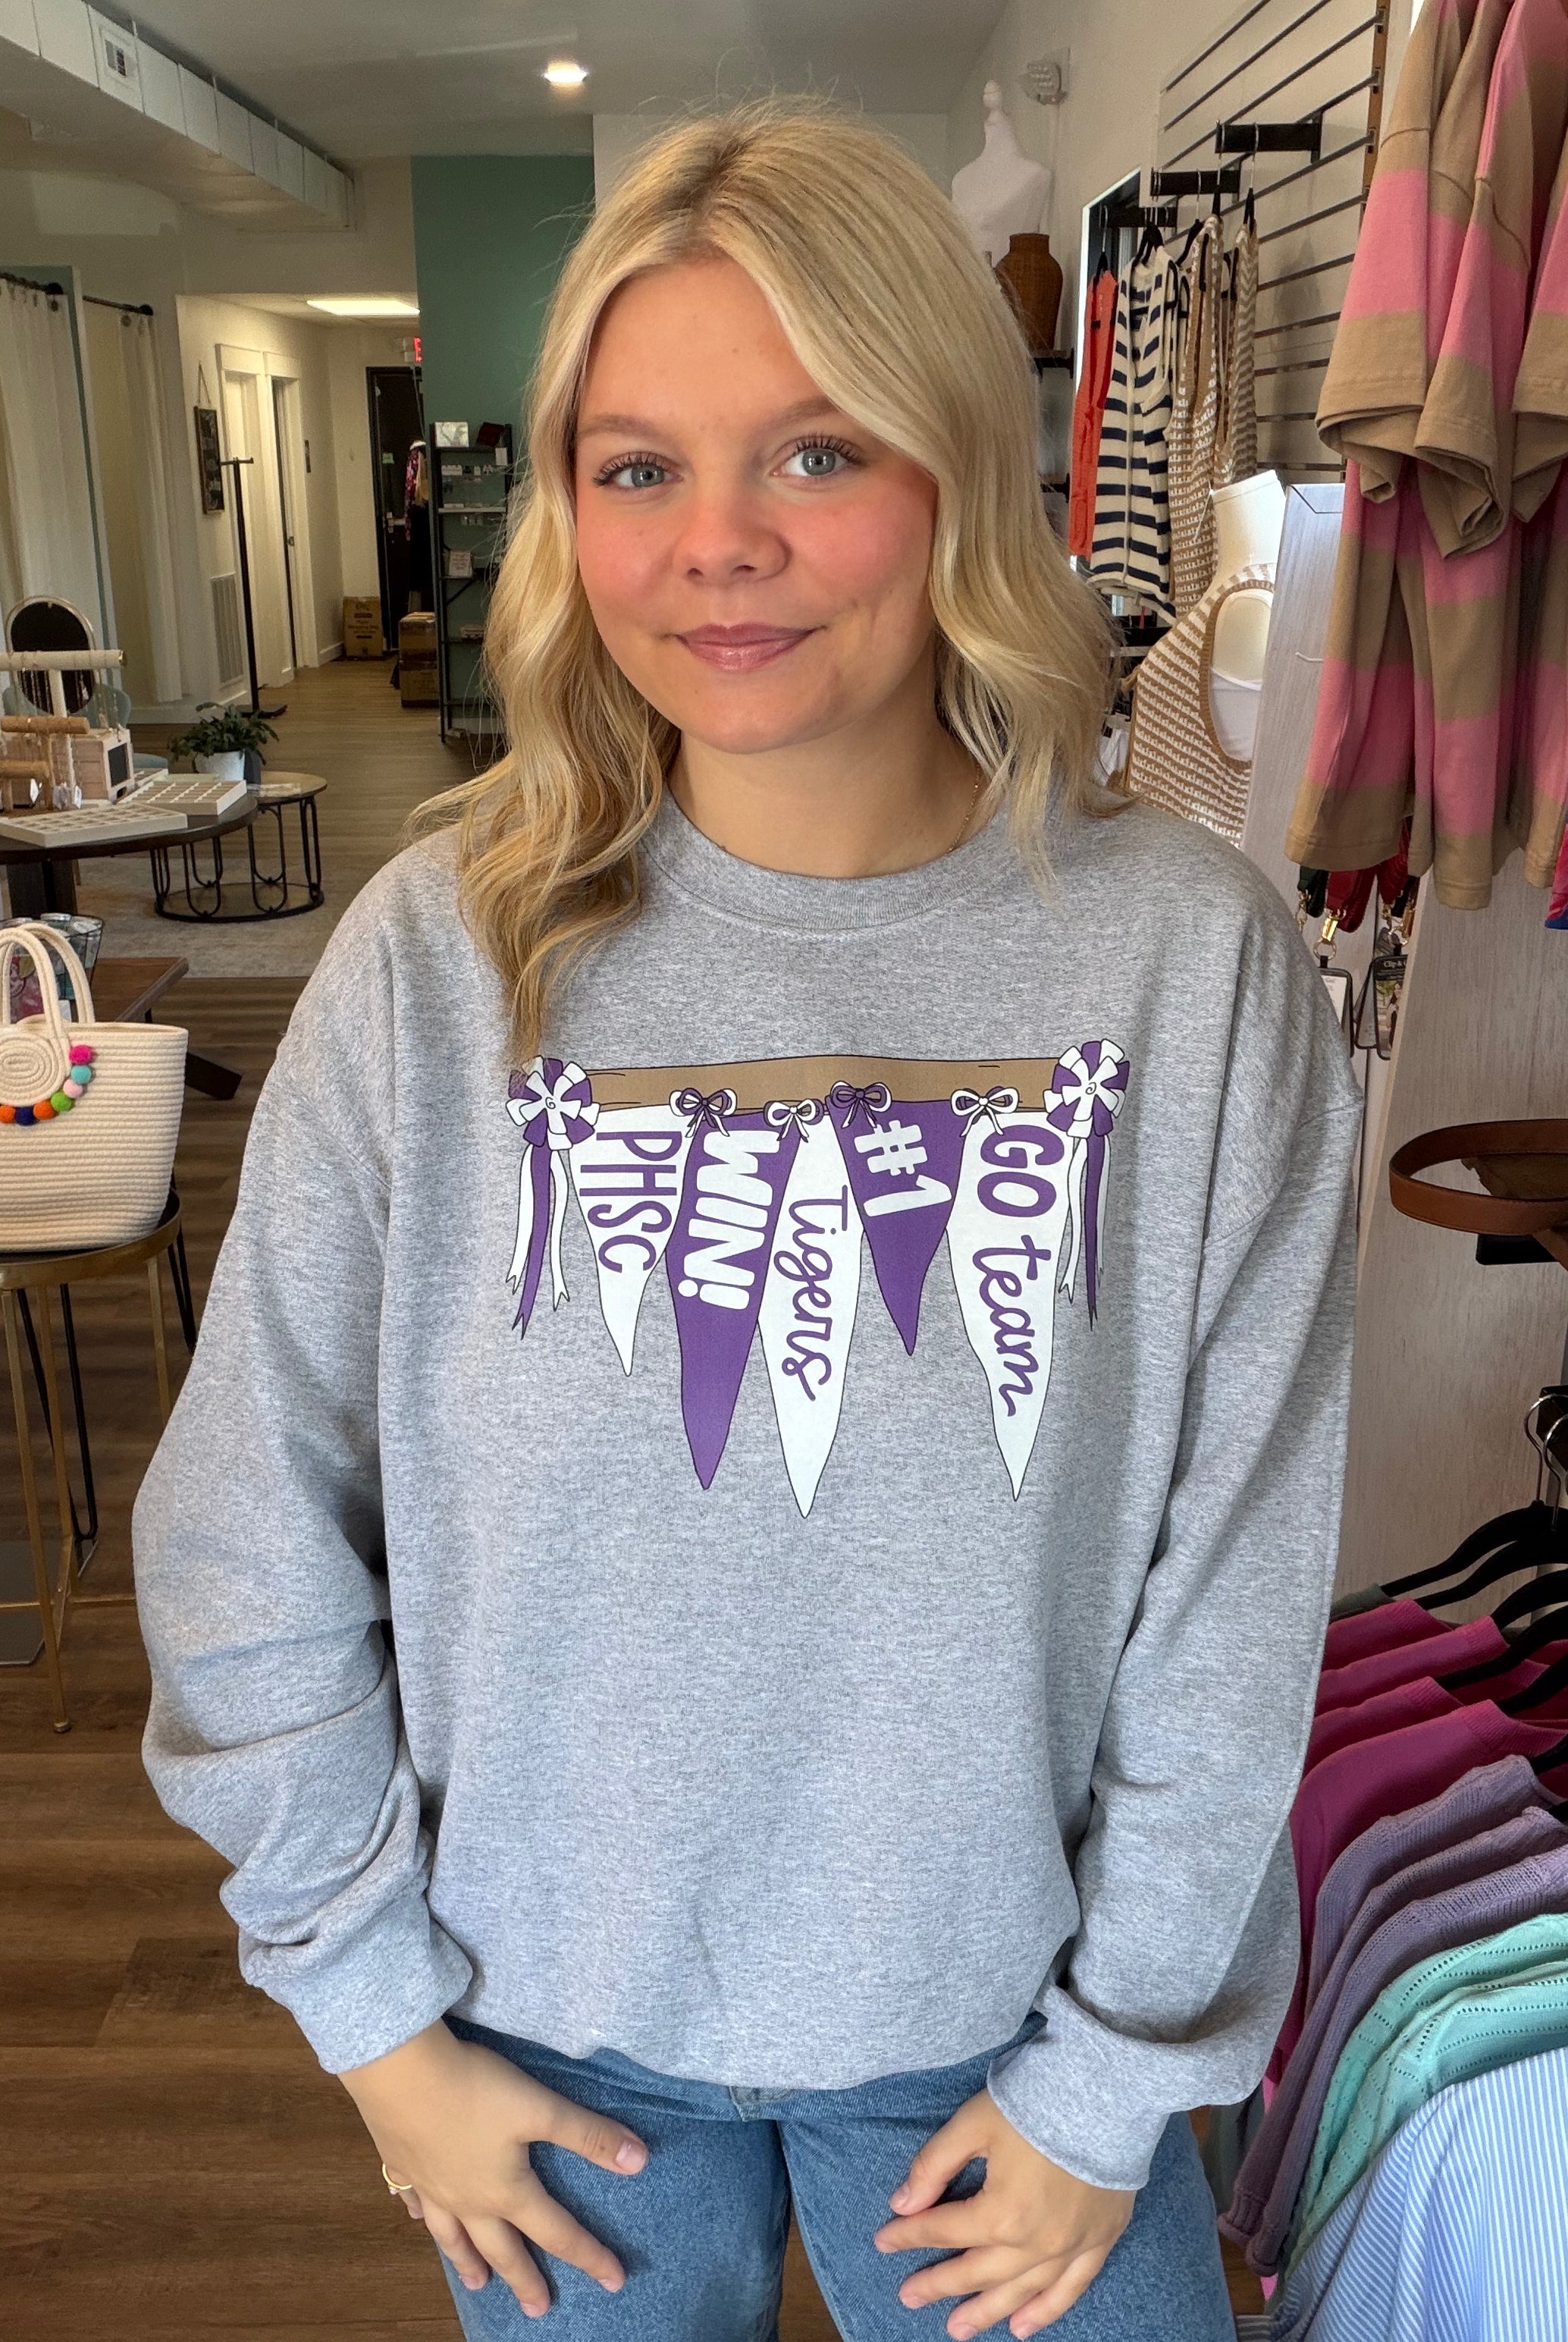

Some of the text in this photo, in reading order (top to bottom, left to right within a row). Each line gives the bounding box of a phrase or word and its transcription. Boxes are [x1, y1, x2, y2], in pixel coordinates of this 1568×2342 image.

[580, 1131, 682, 1273] PHSC
[677, 1130, 779, 1310] WIN!
[855, 1119, 952, 1217] #1
[774, 1185, 848, 1400] Tigers
[973, 1125, 1065, 1417] GO team
